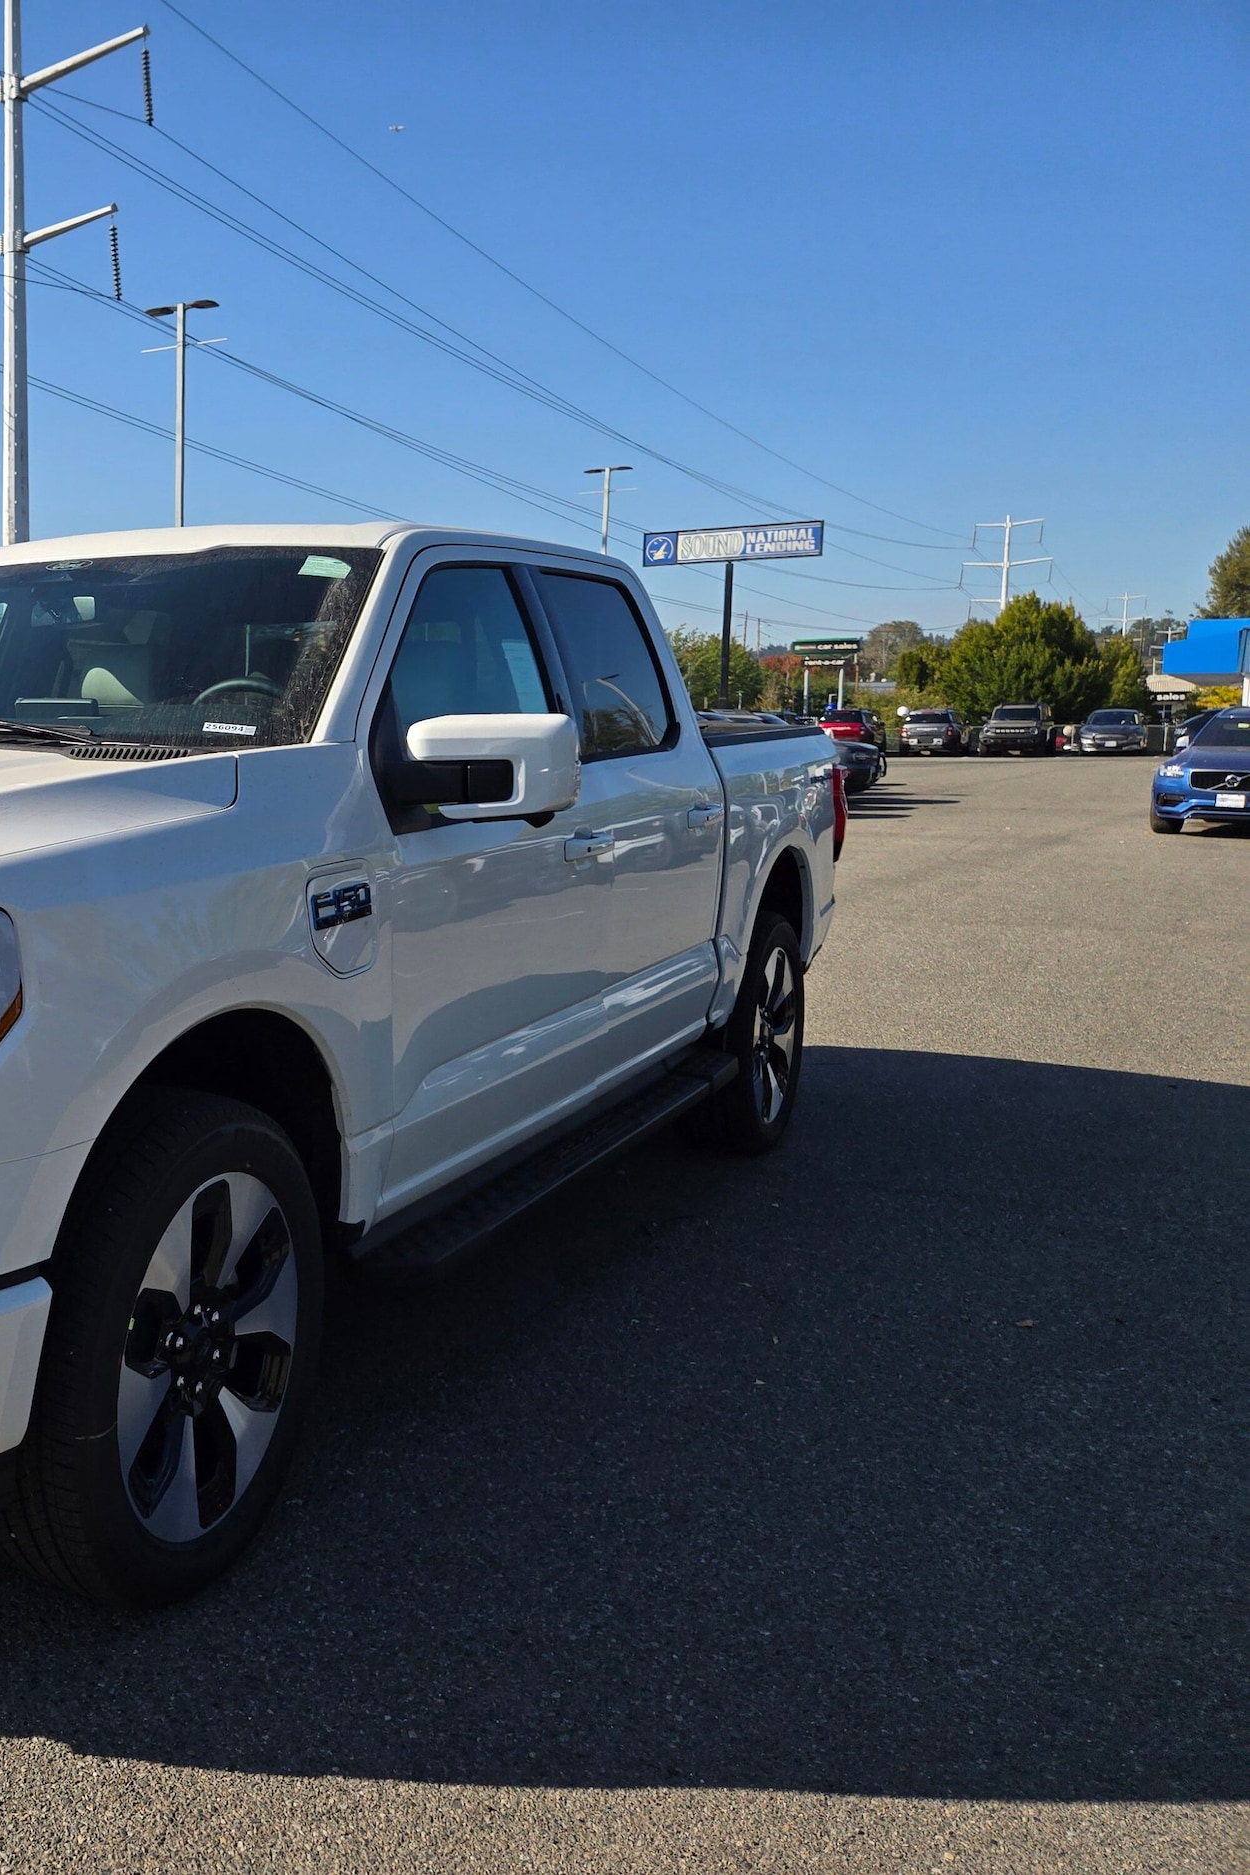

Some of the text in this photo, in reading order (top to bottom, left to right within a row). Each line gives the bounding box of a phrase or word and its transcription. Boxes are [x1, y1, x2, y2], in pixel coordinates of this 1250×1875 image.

[746, 528, 815, 543] NATIONAL
[680, 532, 744, 560] SOUND
[746, 540, 815, 554] LENDING
[205, 723, 244, 732] 256094
